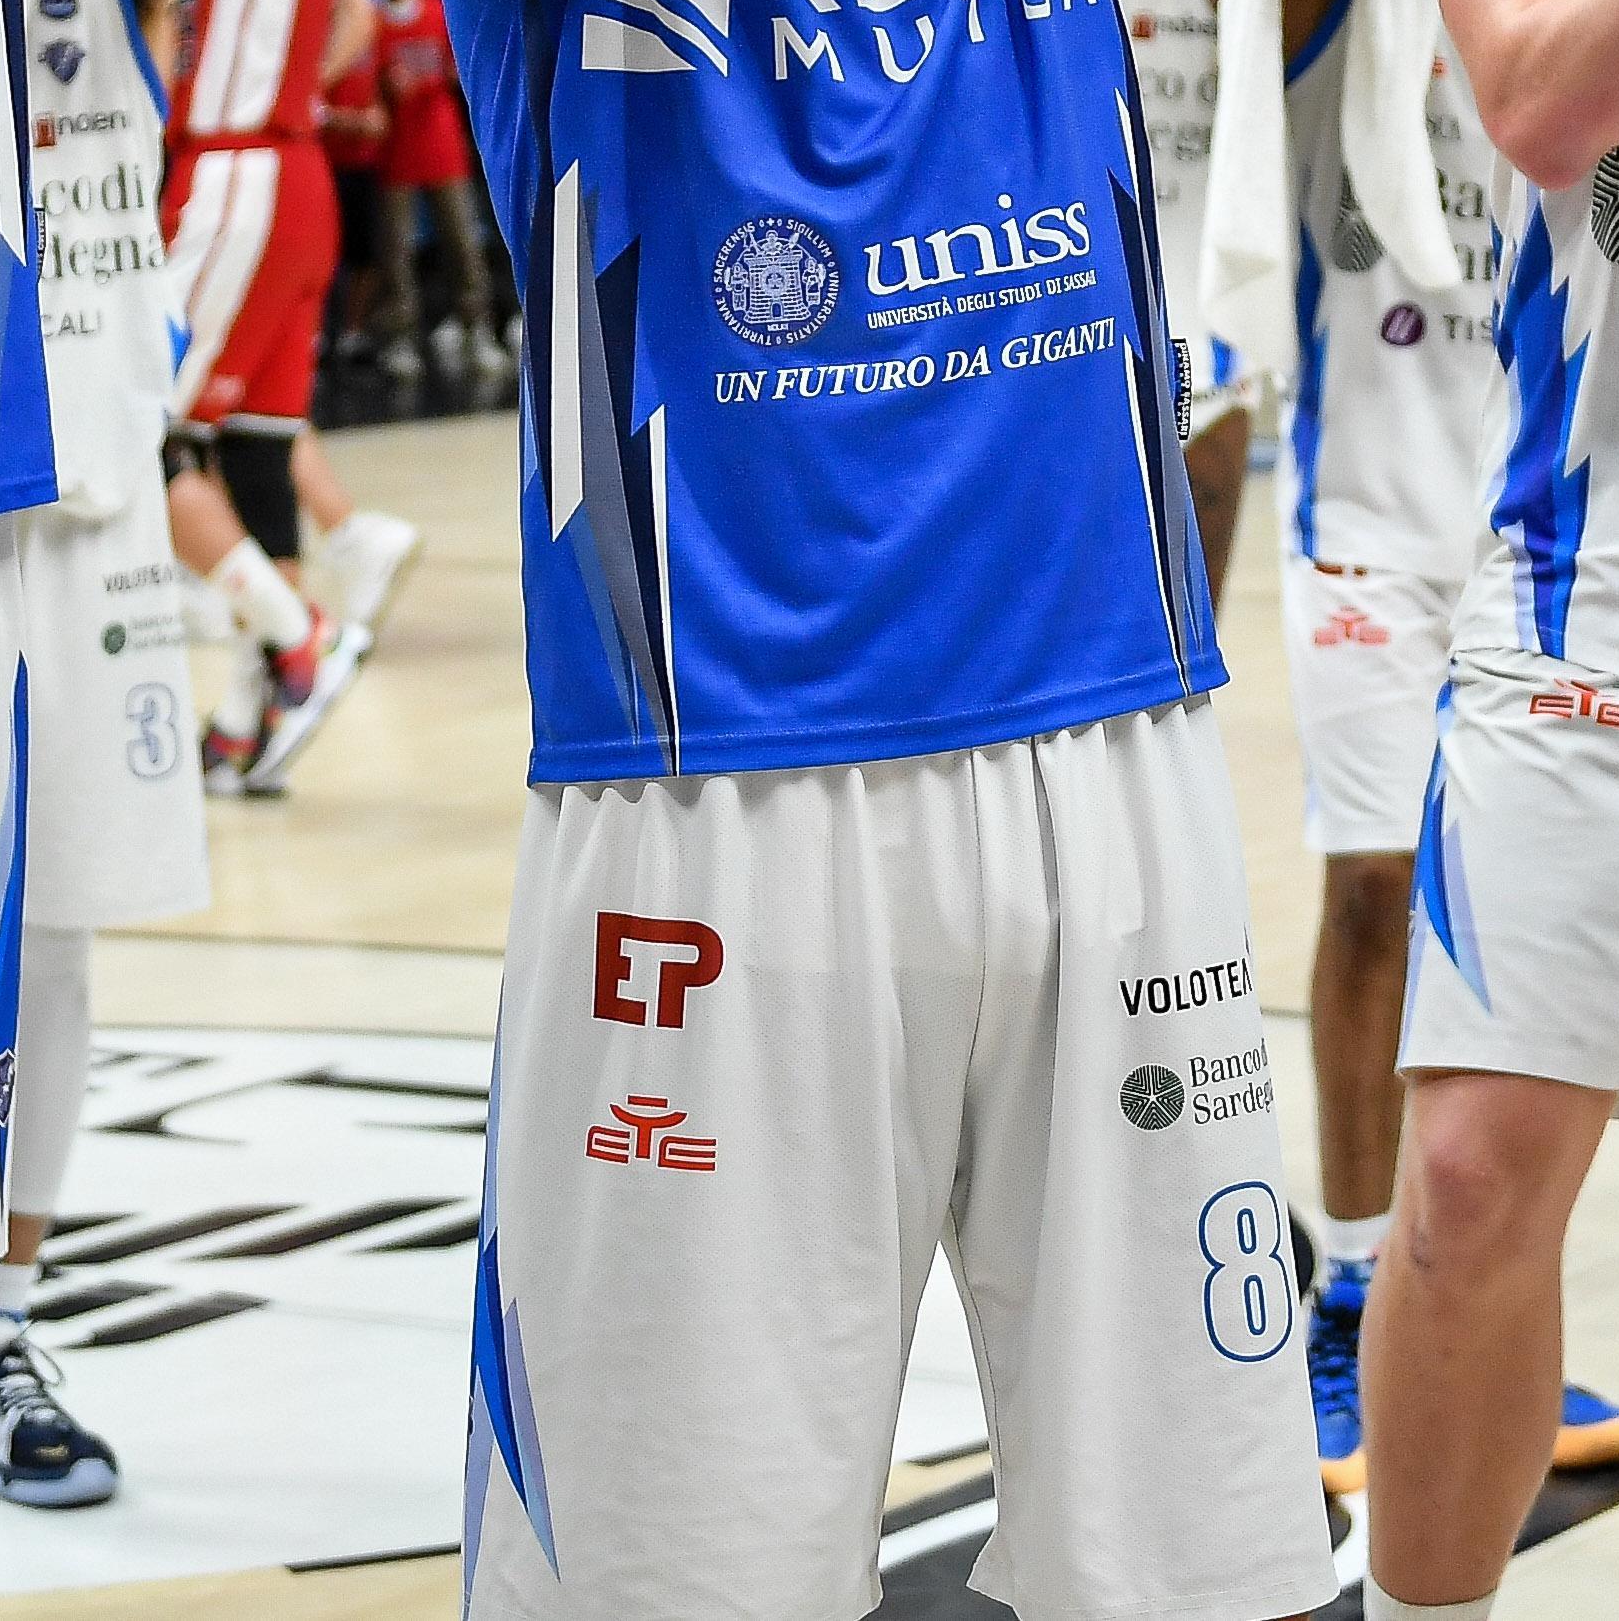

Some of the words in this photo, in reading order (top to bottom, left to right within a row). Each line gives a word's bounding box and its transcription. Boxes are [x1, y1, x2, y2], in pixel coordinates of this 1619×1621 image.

[864, 193, 1090, 296] uniss
[867, 296, 954, 329] UNIVERSITÀ
[956, 290, 996, 314] DEGLI
[998, 282, 1043, 306] STUDI
[1046, 280, 1062, 295] DI
[715, 370, 768, 403] UN
[771, 355, 936, 400] FUTURO
[942, 344, 992, 382] DA
[1000, 317, 1116, 369] GIGANTI
[125, 682, 179, 778] 3
[592, 910, 724, 1029] EP
[1118, 957, 1253, 1016] VOLOTEA
[1188, 1046, 1261, 1088] Banco
[1198, 1179, 1294, 1364] 8
